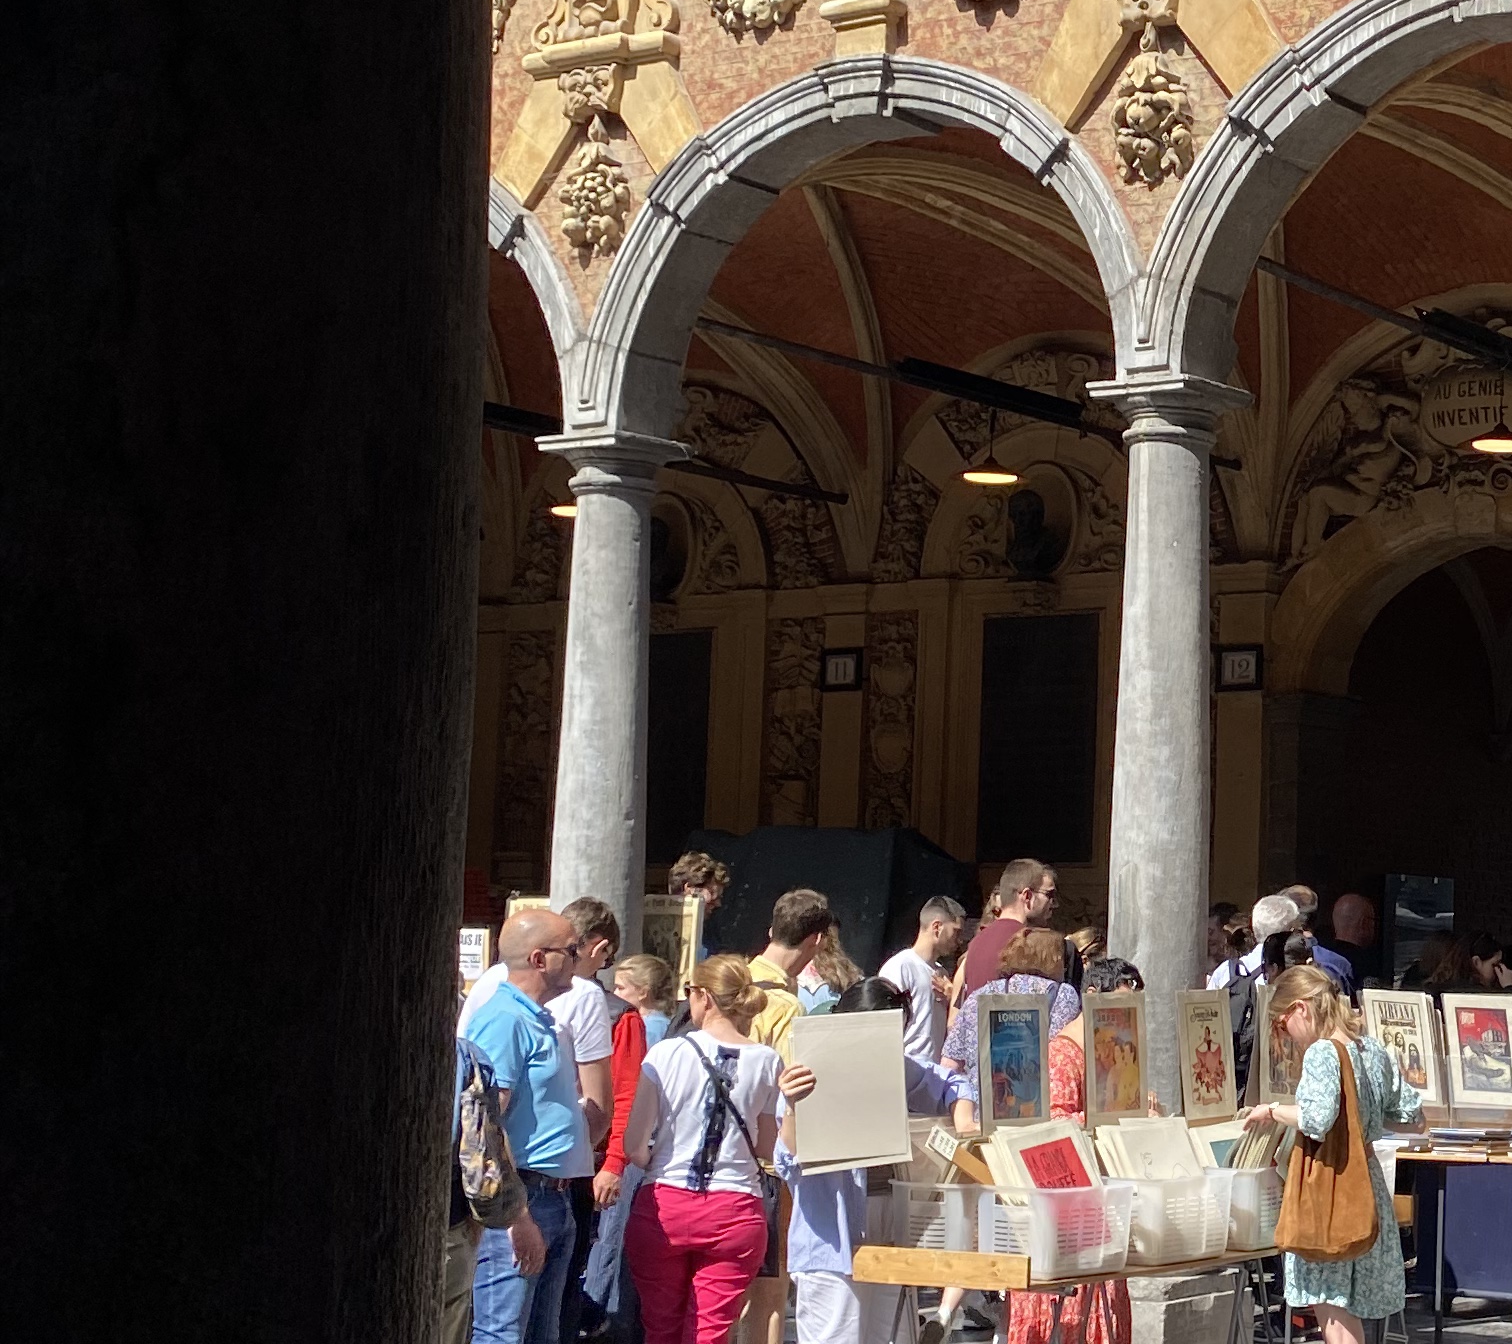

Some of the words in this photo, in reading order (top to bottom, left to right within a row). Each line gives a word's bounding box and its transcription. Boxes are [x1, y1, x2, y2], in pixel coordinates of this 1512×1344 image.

[1434, 383, 1452, 400] AU
[1432, 405, 1508, 429] INVENTIF
[1231, 658, 1250, 679] 12
[998, 1012, 1032, 1023] LONDON
[1378, 1002, 1416, 1020] NIRVANA
